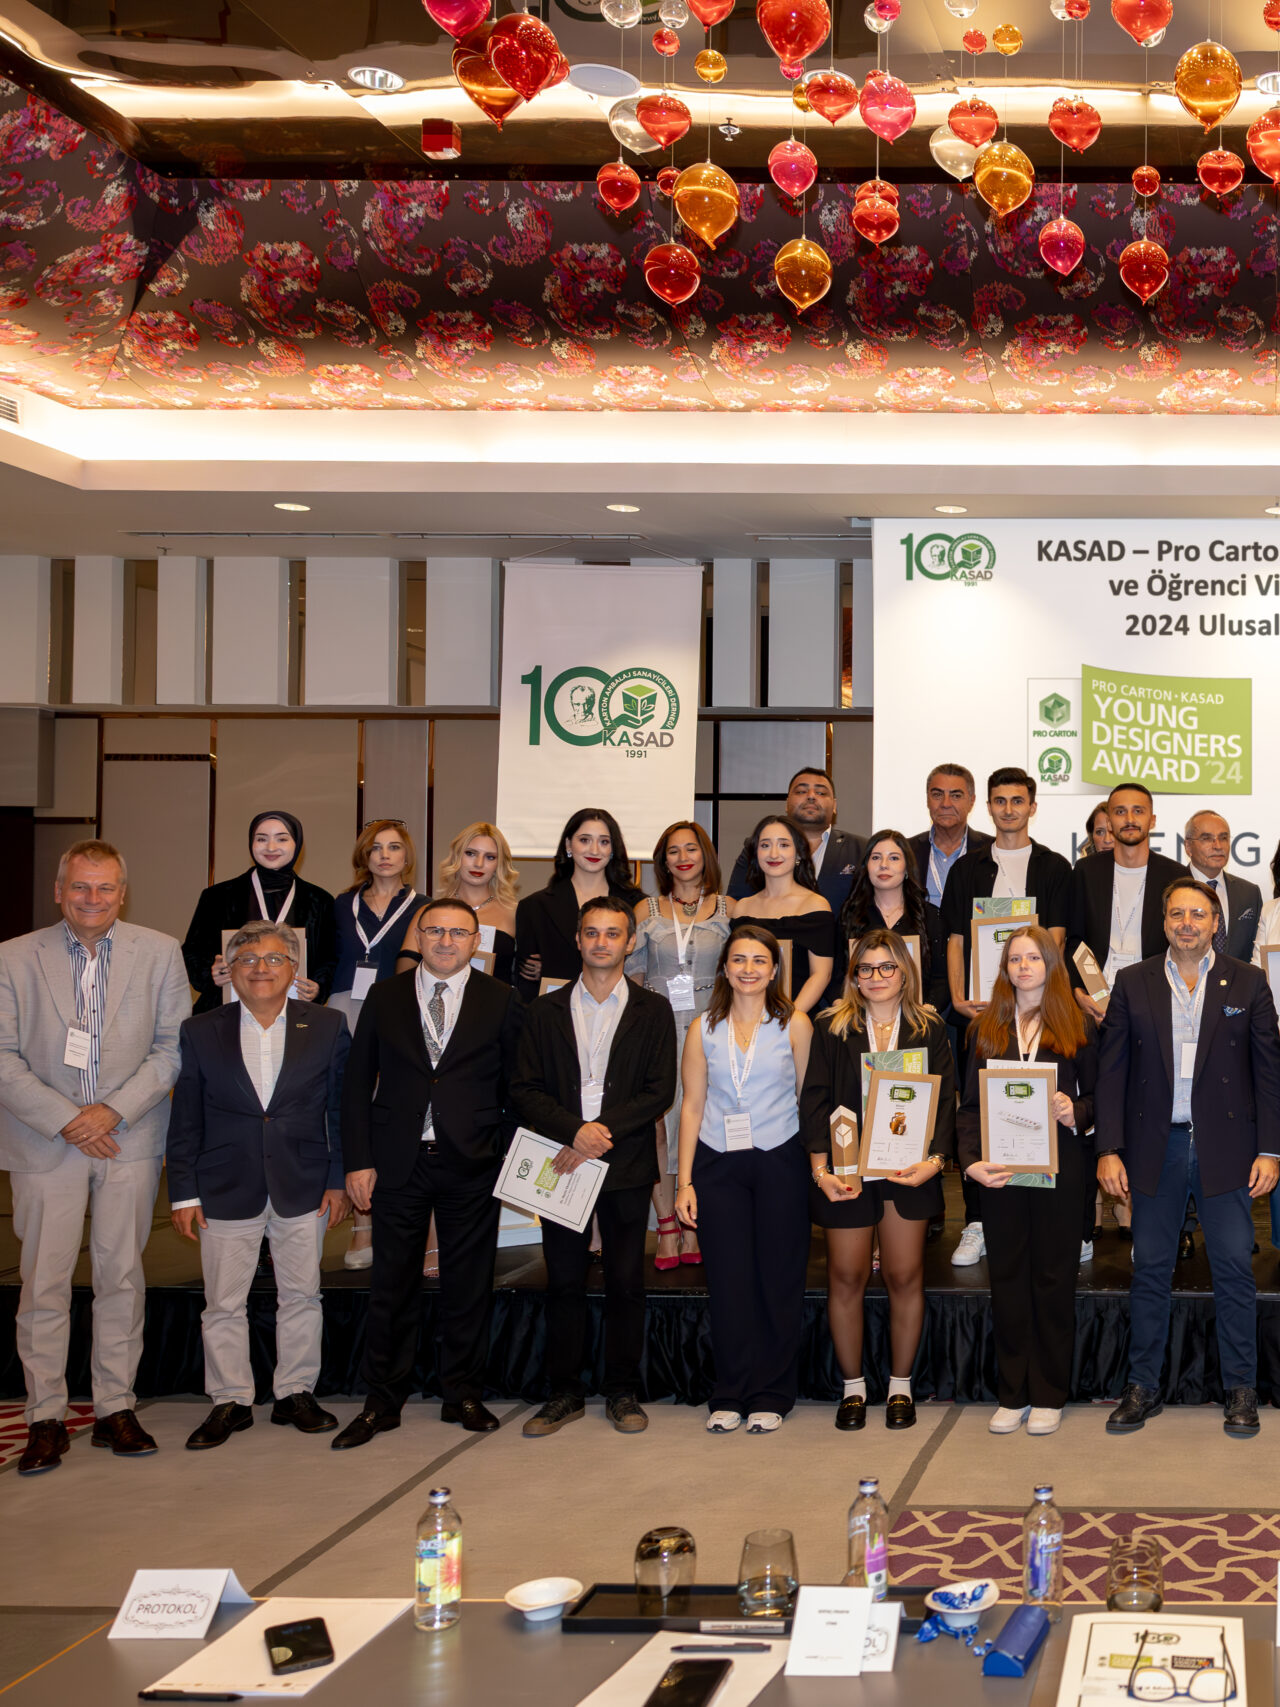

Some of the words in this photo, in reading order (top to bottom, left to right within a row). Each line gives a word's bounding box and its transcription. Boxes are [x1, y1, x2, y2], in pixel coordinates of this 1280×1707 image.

[1037, 540, 1125, 562] KASAD
[1157, 540, 1200, 562] Pro
[950, 570, 993, 581] KASAD
[1108, 579, 1139, 596] ve
[1147, 569, 1247, 601] Öğrenci
[1125, 614, 1190, 636] 2024
[1199, 613, 1280, 636] Ulusal
[605, 672, 631, 697] AMBALAJ
[1091, 679, 1117, 694] PRO
[601, 697, 612, 727] KARTON
[1093, 694, 1199, 730] YOUNG
[602, 729, 675, 748] KASAD
[1033, 730, 1048, 738] PRO
[1049, 730, 1077, 738] CARTON
[1092, 721, 1243, 758] DESIGNERS
[625, 749, 647, 758] 1991
[1092, 749, 1200, 784] AWARD
[1040, 774, 1070, 782] KASAD
[136, 1603, 199, 1615] PROTOKOL
